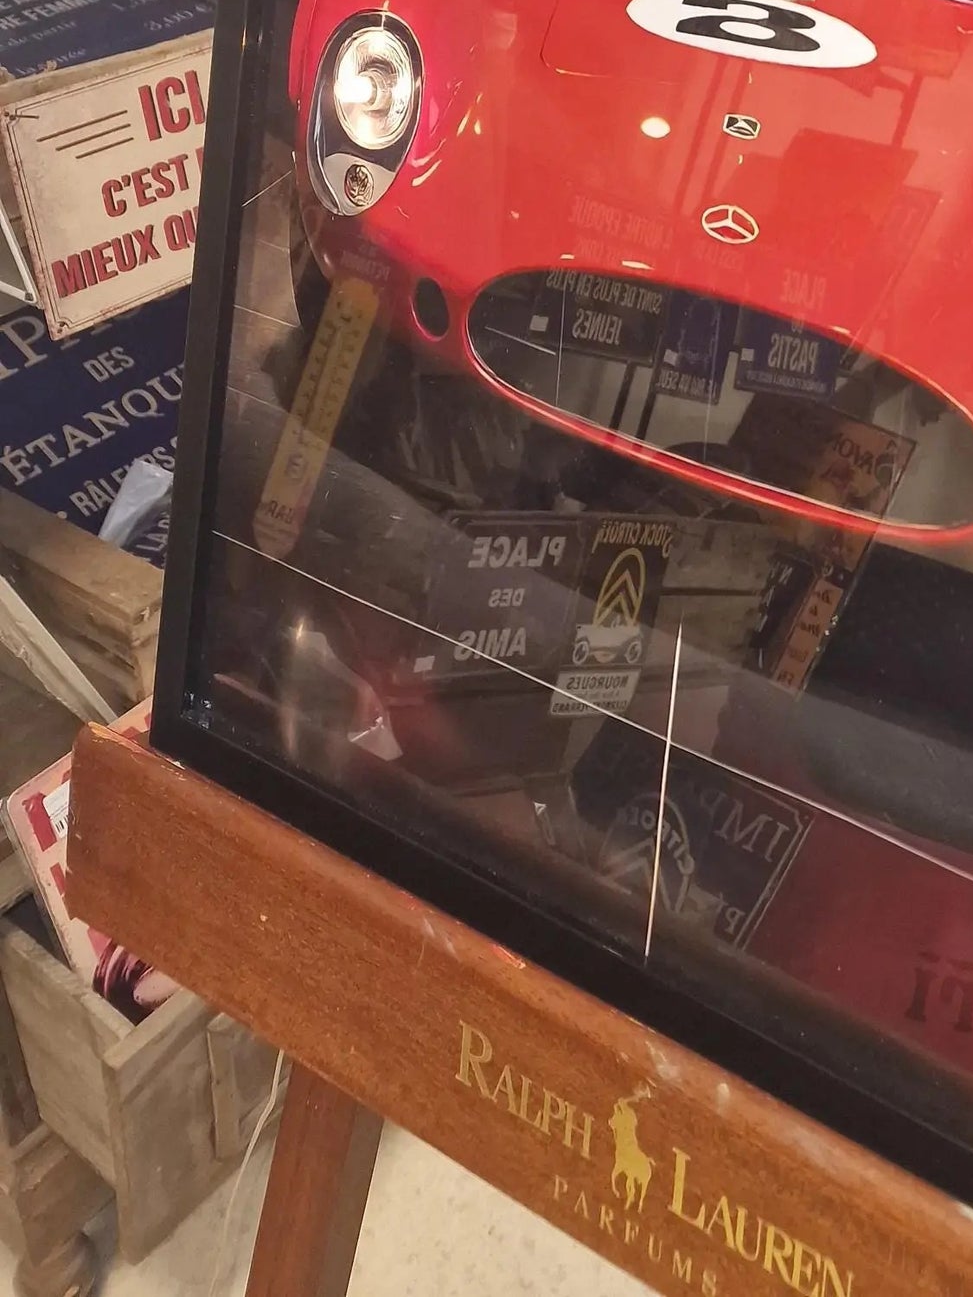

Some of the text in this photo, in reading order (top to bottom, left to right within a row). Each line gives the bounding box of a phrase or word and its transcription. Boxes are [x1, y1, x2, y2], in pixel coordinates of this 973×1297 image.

[138, 69, 206, 142] ICI
[101, 152, 189, 219] C'EST
[51, 227, 160, 299] MIEUX
[82, 345, 134, 383] DES
[454, 1019, 595, 1161] RALPH
[552, 1174, 718, 1297] PARFUMS
[667, 1147, 855, 1297] LAUREN
